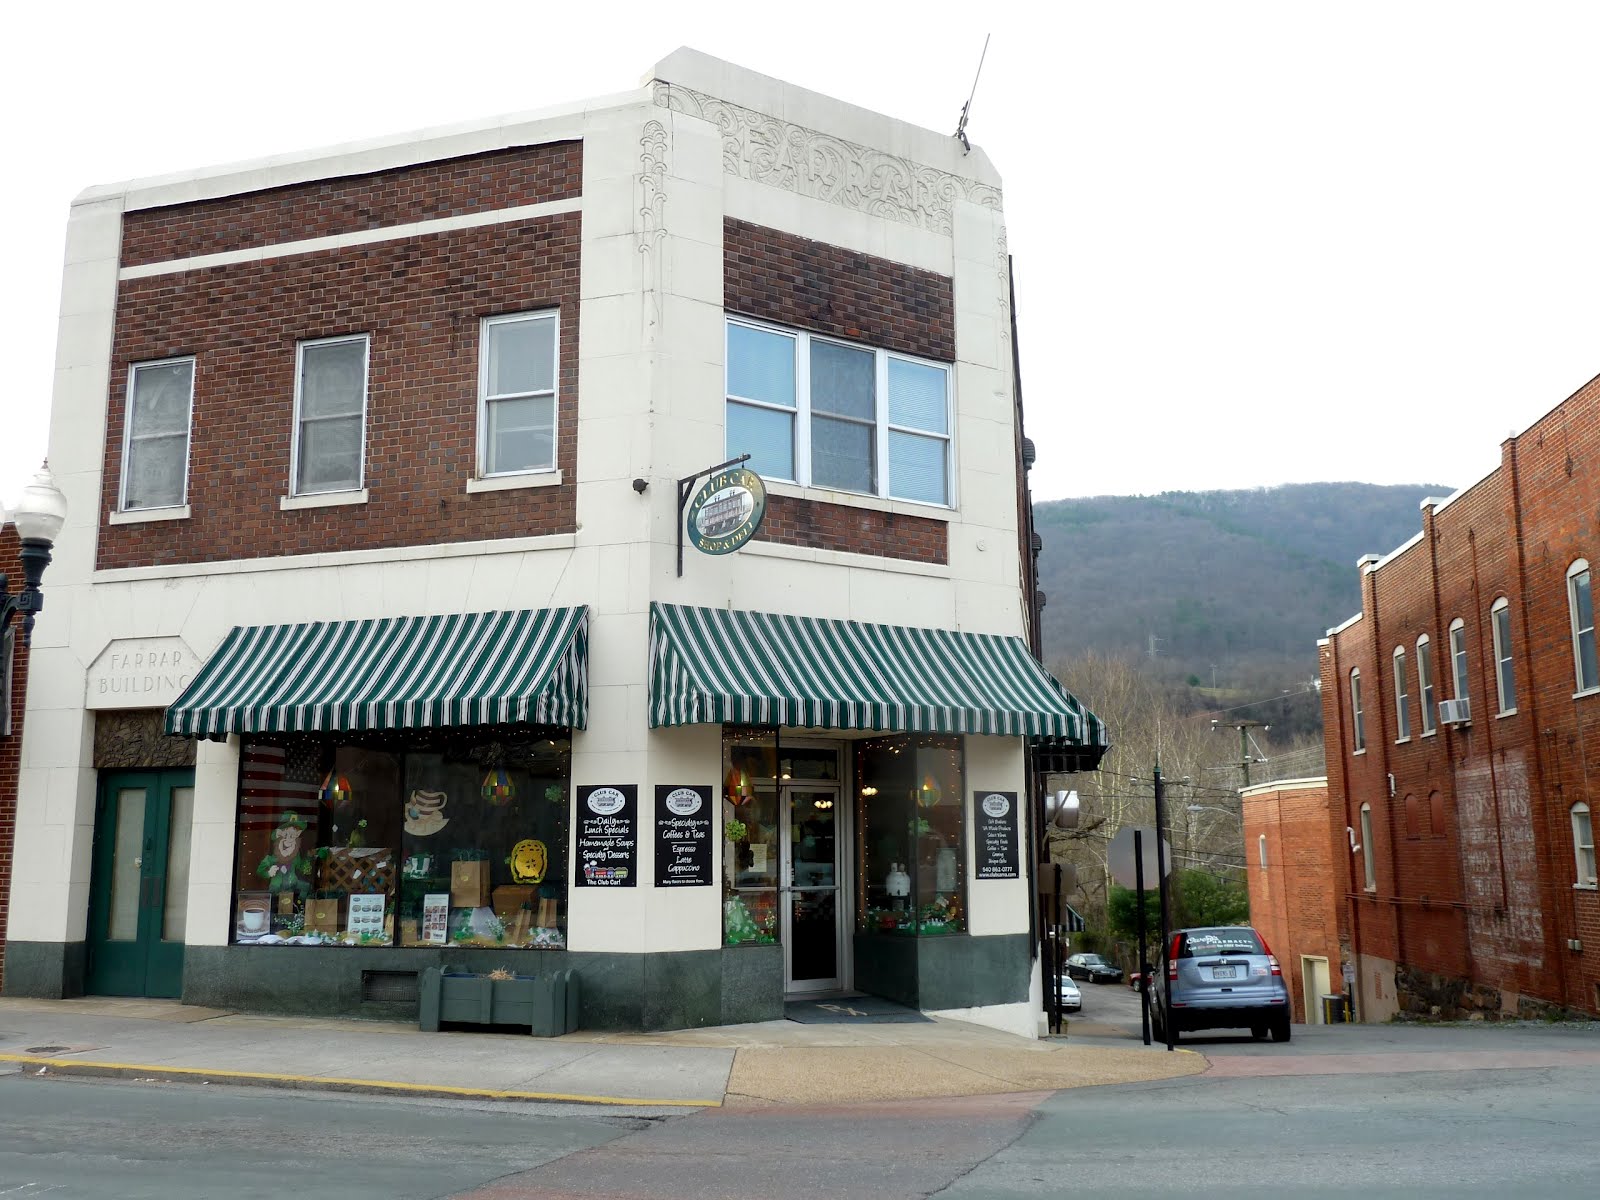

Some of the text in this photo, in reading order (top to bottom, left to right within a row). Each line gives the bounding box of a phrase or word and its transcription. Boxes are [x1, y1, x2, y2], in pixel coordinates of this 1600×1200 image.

[694, 472, 754, 508] CLUB CAR
[699, 521, 753, 551] SHOP & DELI
[111, 651, 182, 670] FARRAR
[593, 790, 619, 798] CLUB CAR
[686, 791, 696, 799] CAR
[596, 816, 617, 828] Daily
[671, 817, 697, 830] Specialty
[584, 824, 629, 836] Lunch Specials
[662, 829, 684, 840] Coffees
[691, 829, 706, 839] Teas
[579, 838, 635, 850] Homemade Soups
[672, 844, 697, 856] Espresso
[582, 849, 630, 862] Specialty Desserts
[668, 864, 700, 874] Cappuccino
